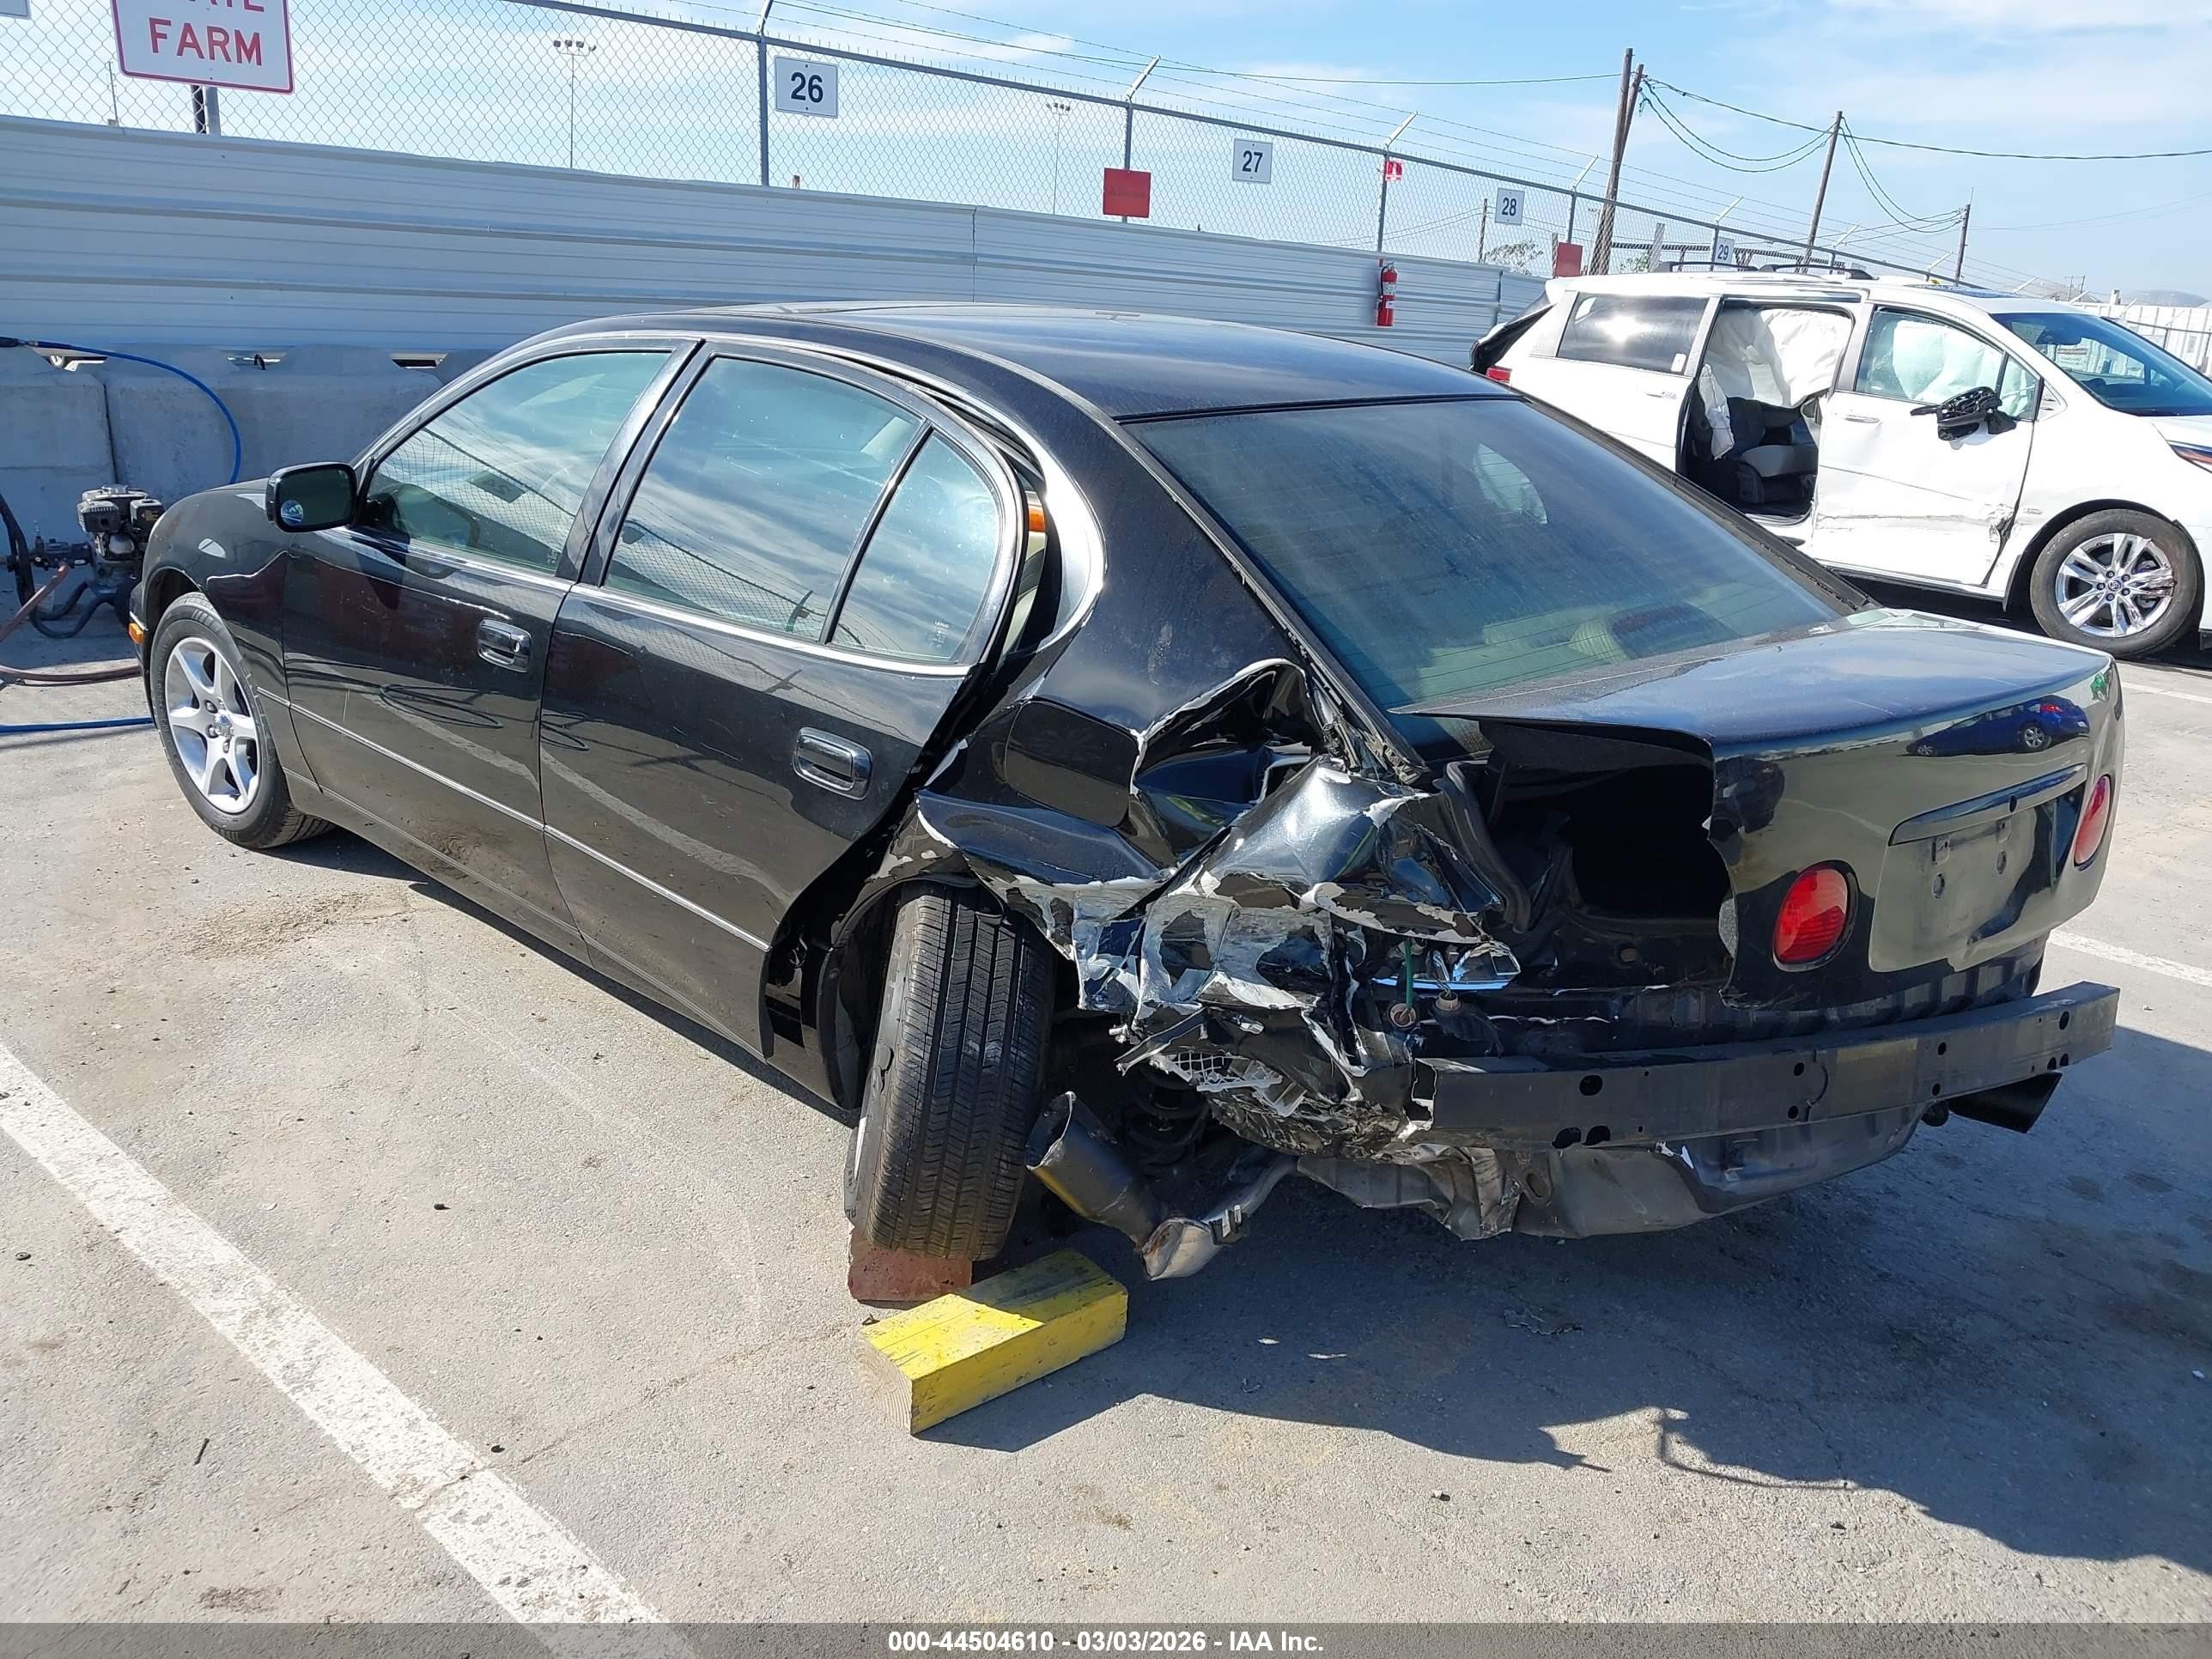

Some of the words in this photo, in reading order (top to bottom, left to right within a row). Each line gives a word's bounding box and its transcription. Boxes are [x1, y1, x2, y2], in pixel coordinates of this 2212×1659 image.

[149, 17, 262, 66] FARM
[791, 71, 823, 103] 26
[1242, 149, 1263, 173] 27
[1502, 197, 1517, 216] 28
[1717, 244, 1729, 261] 29
